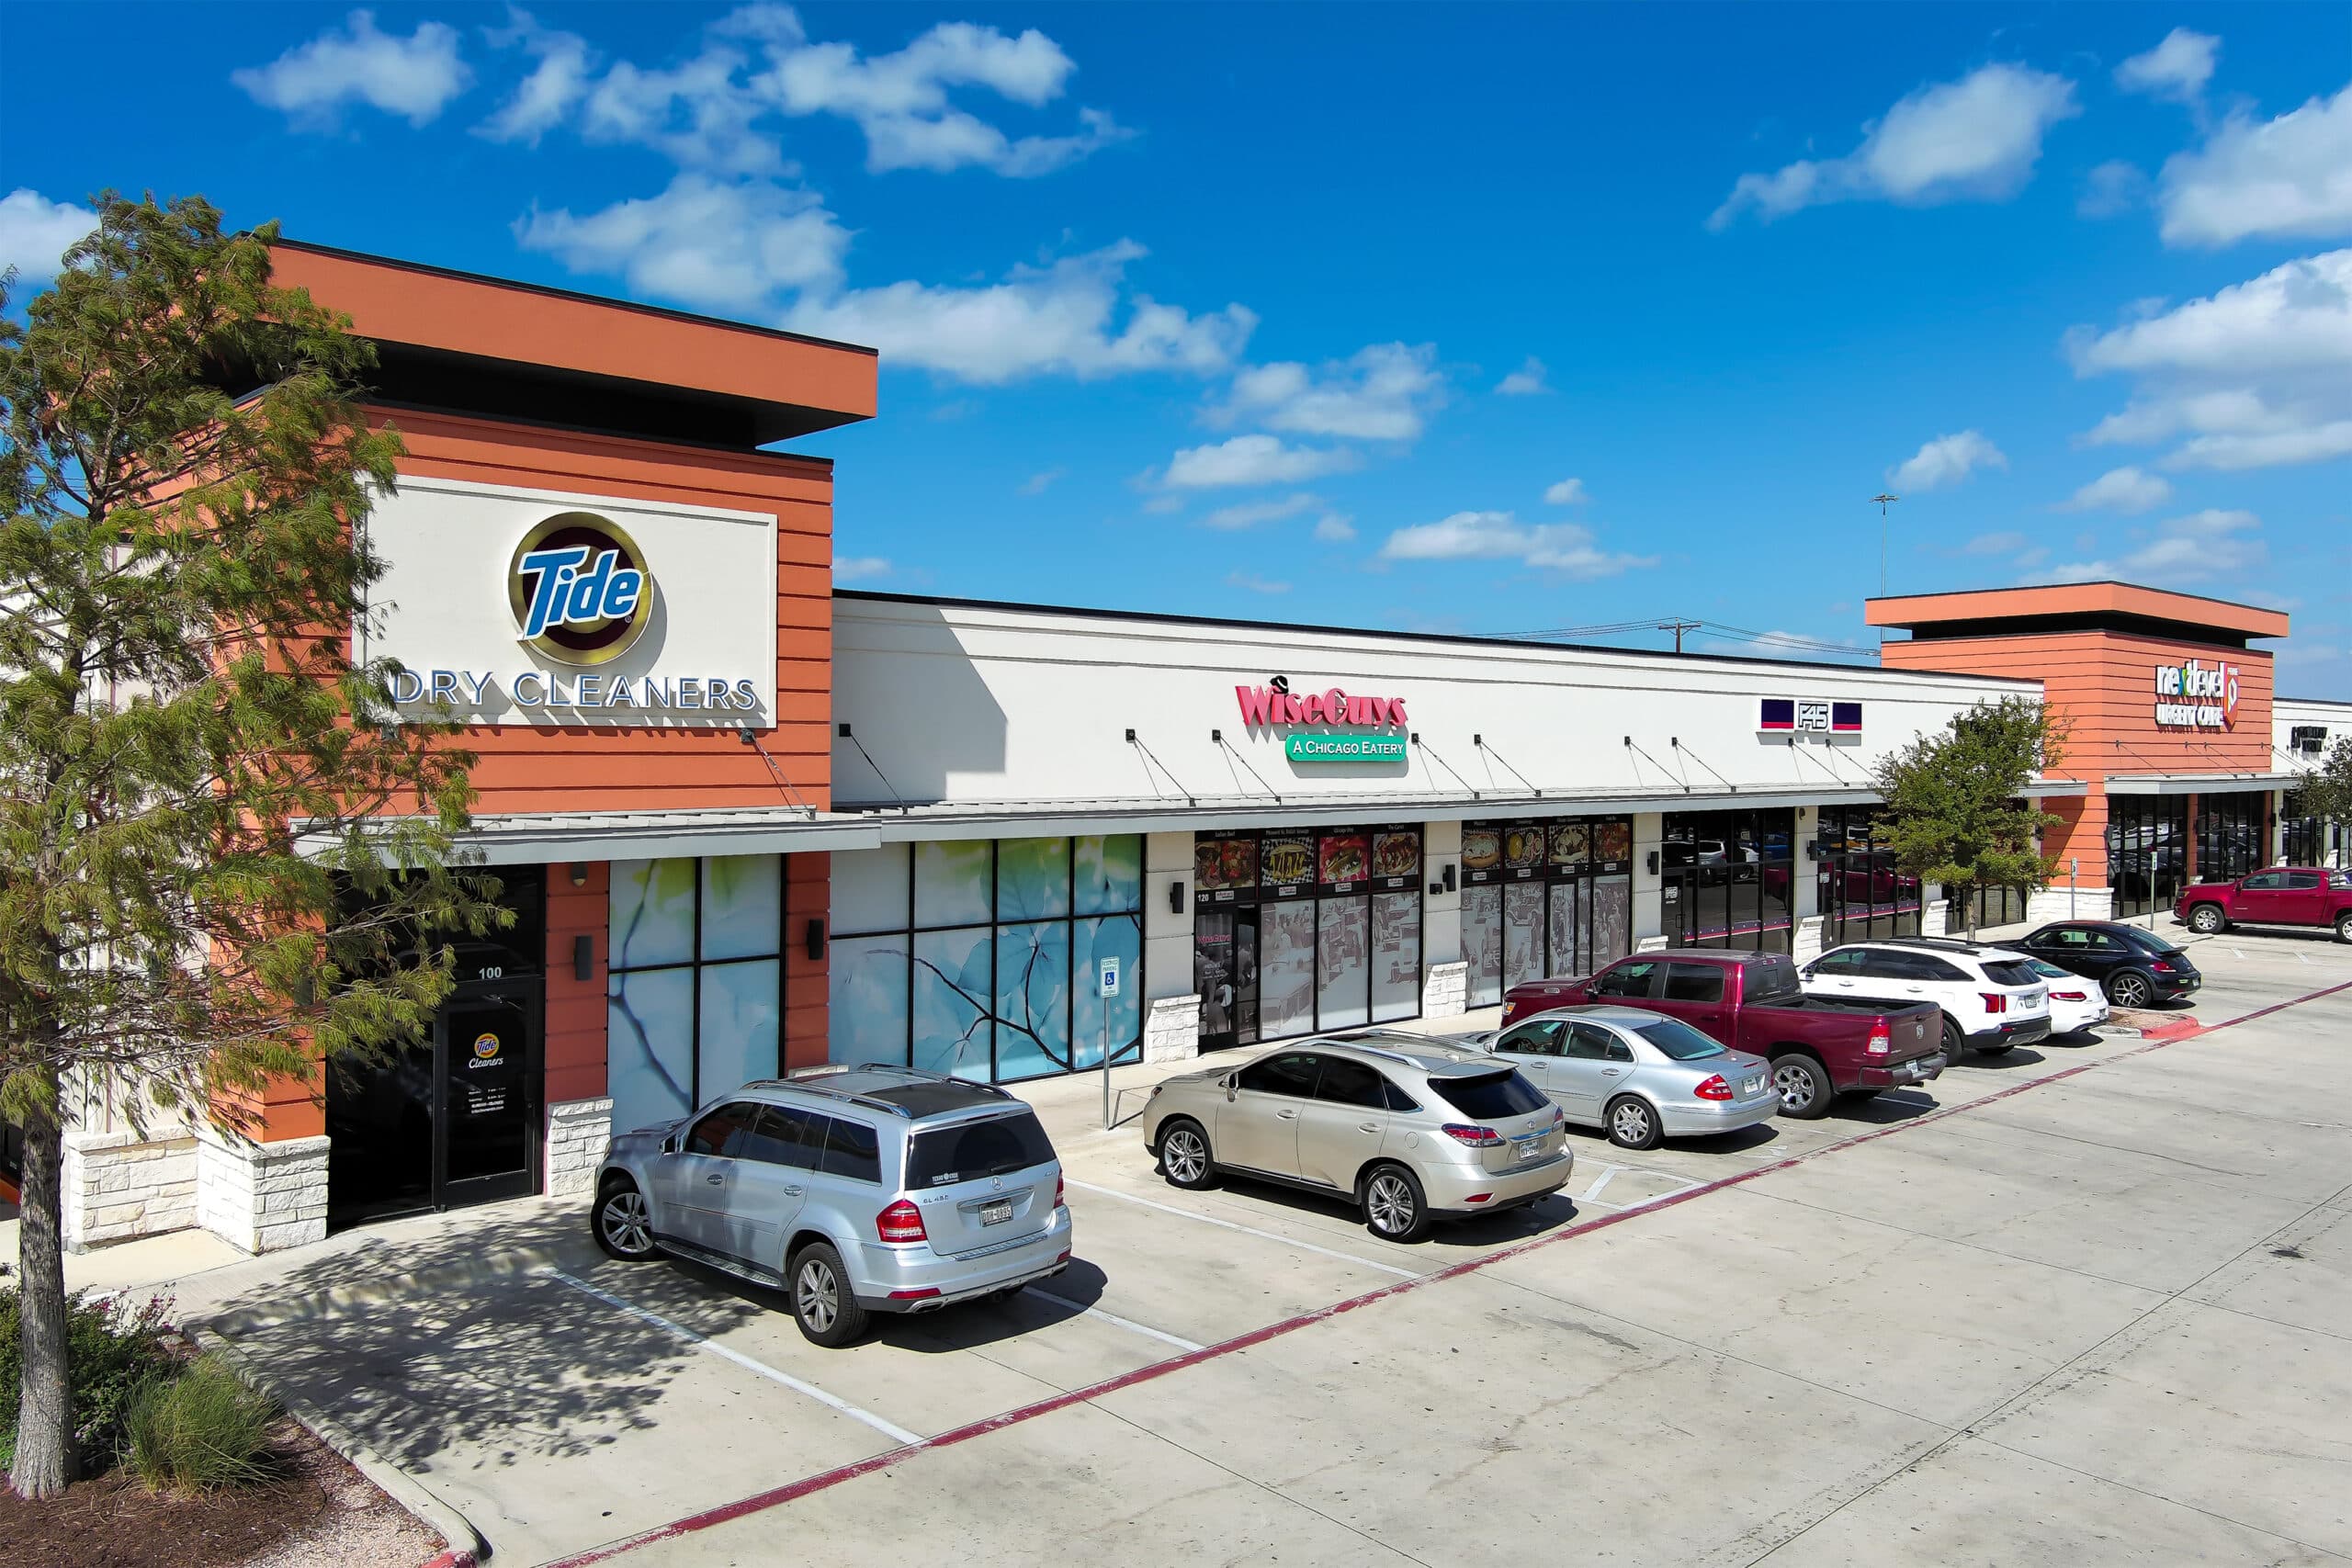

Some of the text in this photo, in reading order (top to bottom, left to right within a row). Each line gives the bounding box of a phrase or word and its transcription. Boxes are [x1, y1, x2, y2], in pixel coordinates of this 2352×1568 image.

[517, 546, 641, 640] Tide
[391, 669, 757, 711] DRY CLEANERS
[1235, 684, 1408, 727] WiseGuys
[2155, 703, 2224, 727] URGENT CARE
[1799, 704, 1828, 728] F45
[1293, 740, 1404, 757] A CHICAGO EATERY
[1198, 894, 1209, 902] 120
[479, 966, 503, 979] 100
[477, 1038, 497, 1055] Tide
[469, 1057, 503, 1069] Cleaners
